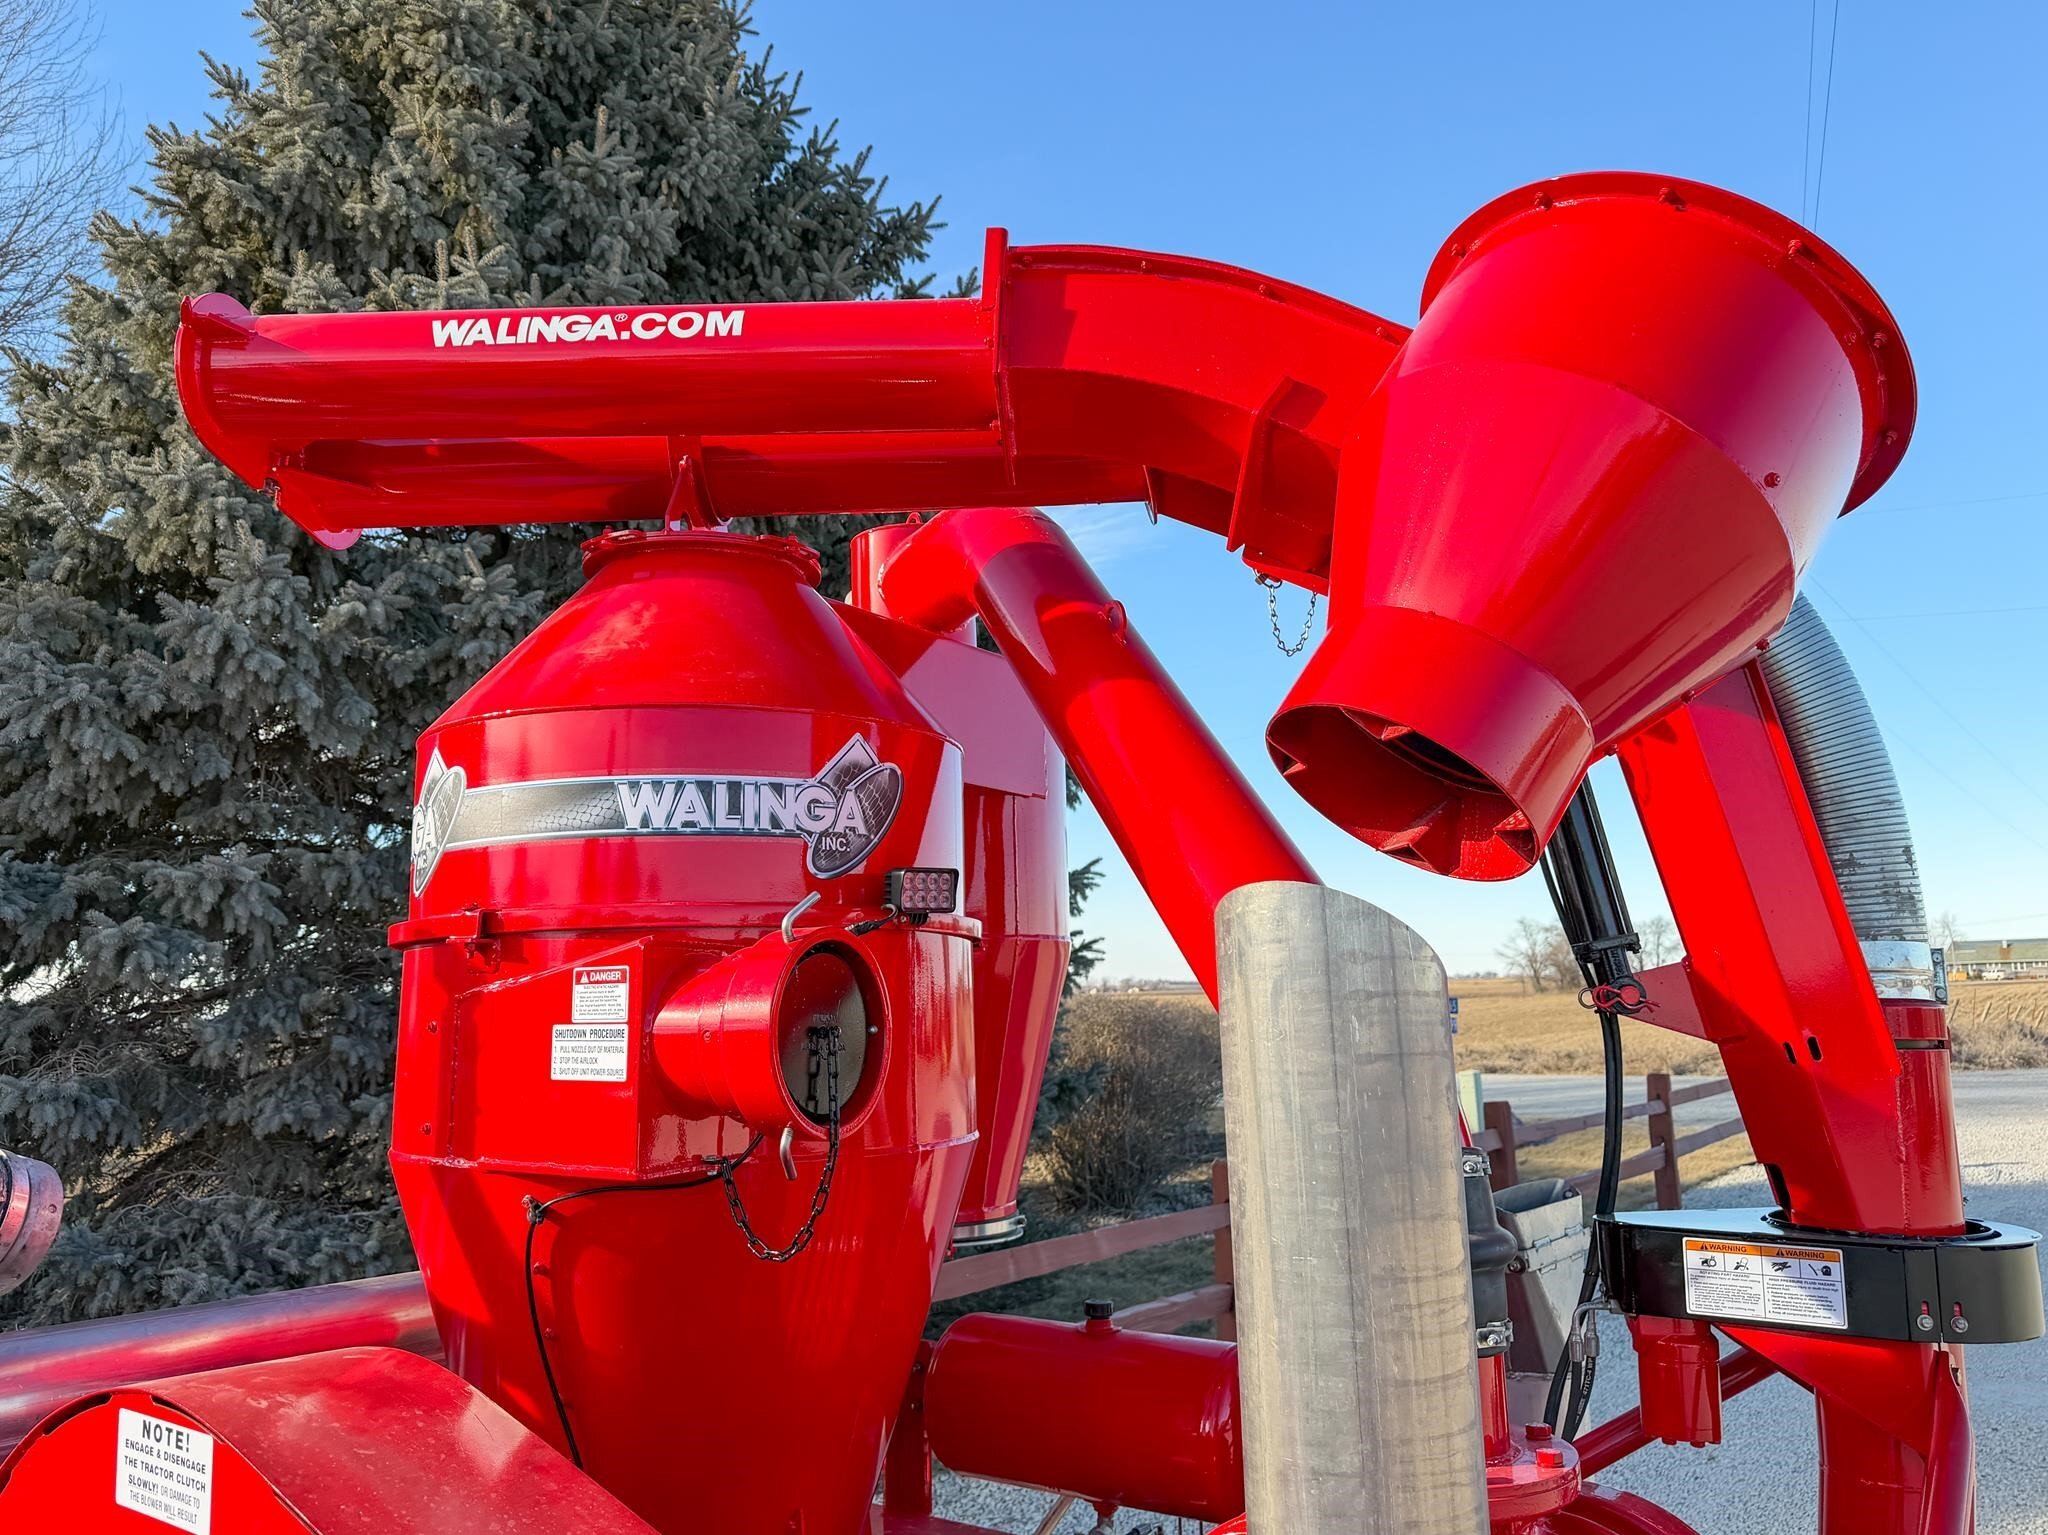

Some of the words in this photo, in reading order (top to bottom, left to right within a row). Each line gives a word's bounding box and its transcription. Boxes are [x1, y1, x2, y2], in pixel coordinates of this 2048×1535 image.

[616, 782, 869, 836] WALINGA
[822, 836, 851, 852] INC.
[590, 971, 622, 982] DANGER
[554, 1029, 587, 1039] SHUTDOWN
[589, 1029, 625, 1039] PROCEDURE
[603, 1046, 625, 1054] MATERIAL
[591, 1068, 606, 1076] POWER
[1709, 1243, 1747, 1253] WARNING
[1785, 1249, 1825, 1259] WARNING
[142, 1419, 190, 1453] NOTE!
[125, 1438, 154, 1457] ENGAGE
[156, 1448, 161, 1459] &
[163, 1451, 206, 1475] DISENGAGE
[124, 1455, 138, 1469] THE
[140, 1461, 174, 1482] TRACTOR
[176, 1473, 206, 1493] CLUTCH
[128, 1474, 159, 1494] SLOWLY!
[160, 1485, 169, 1496] OR
[169, 1489, 192, 1506] DAMAGE
[193, 1497, 200, 1510] TO
[130, 1490, 140, 1503] THE
[140, 1494, 163, 1512] BLOWER
[163, 1502, 176, 1517] WILL
[177, 1508, 197, 1524] RESULT
